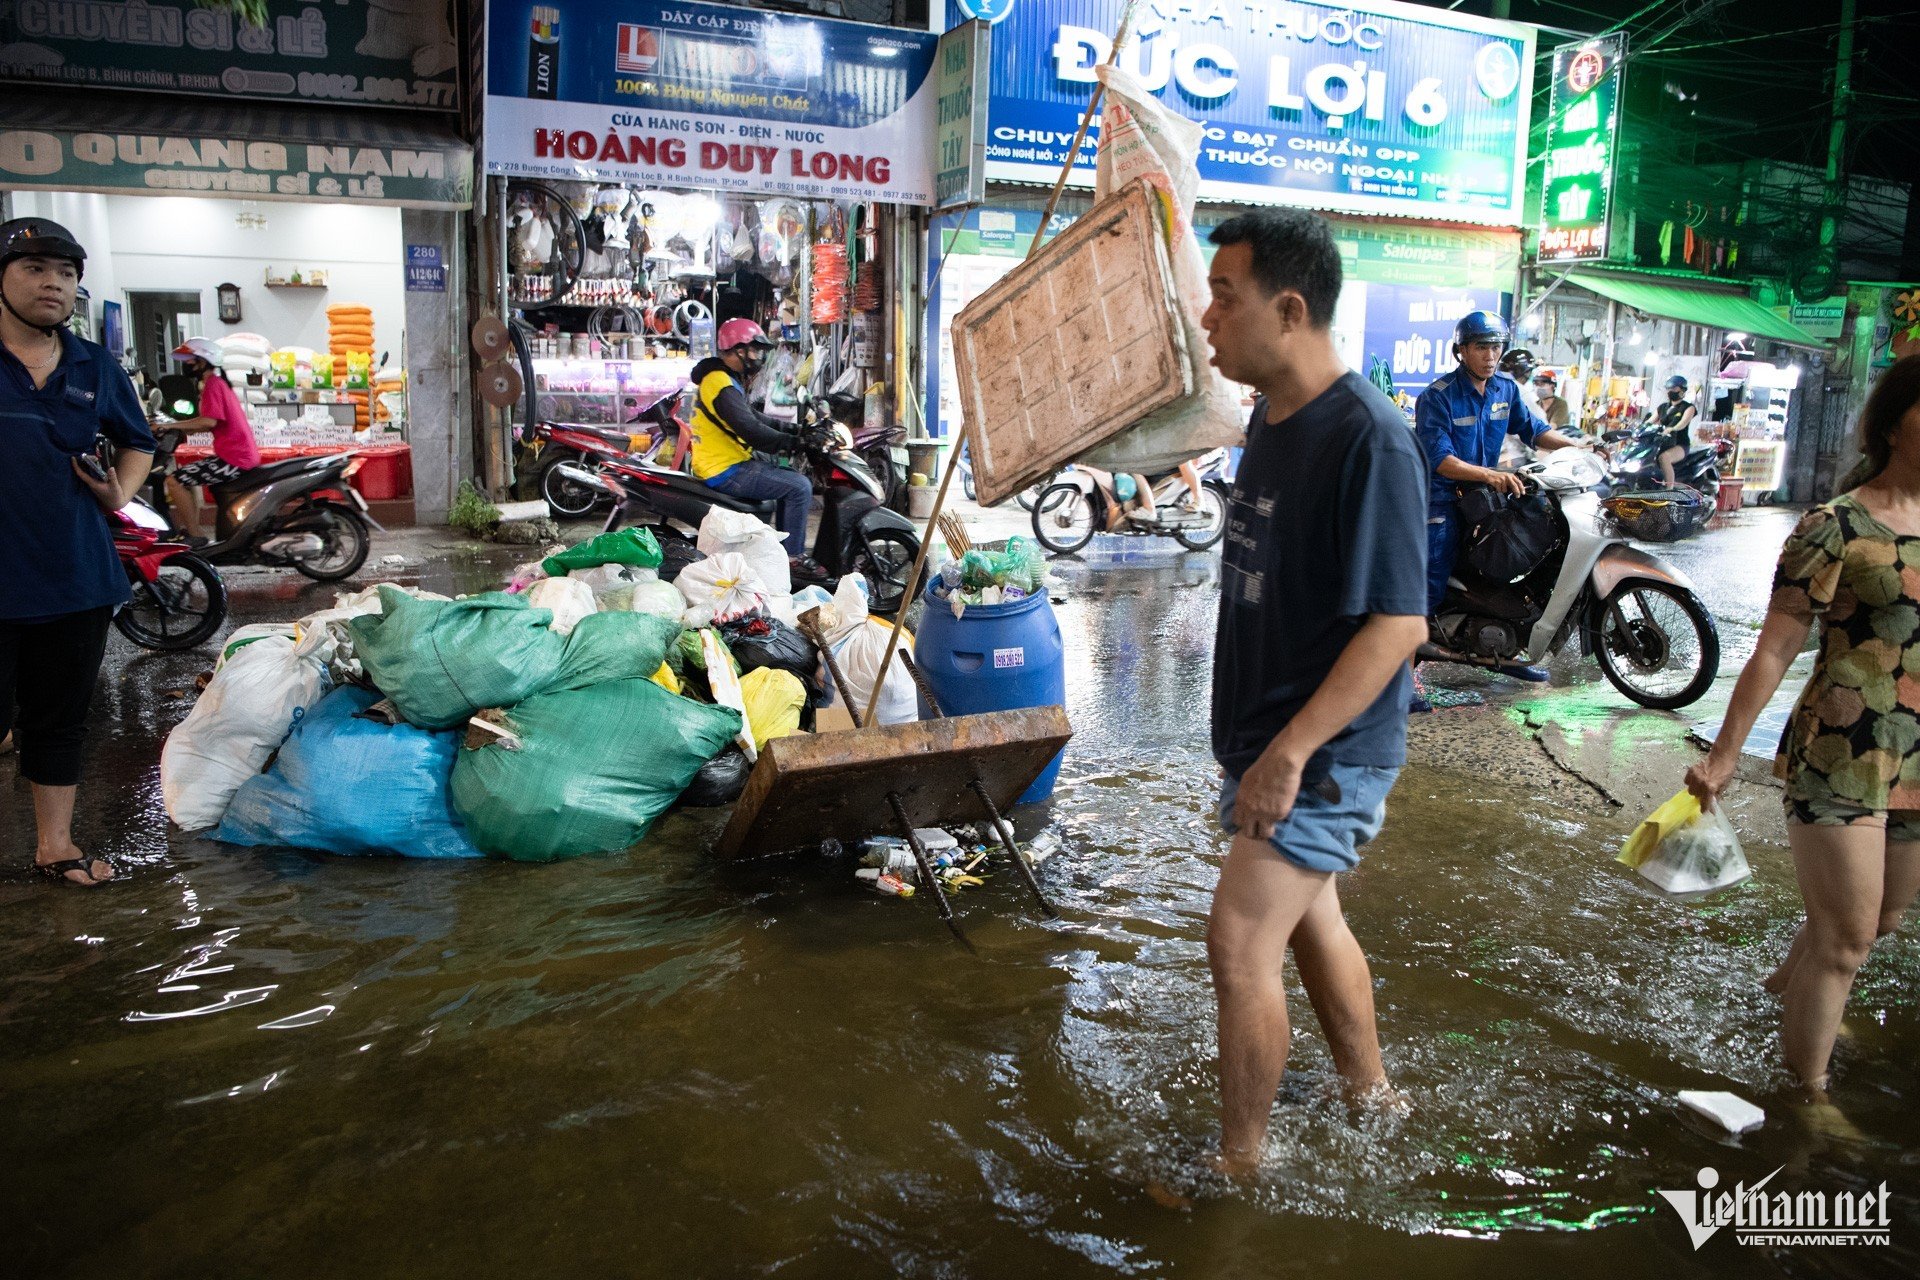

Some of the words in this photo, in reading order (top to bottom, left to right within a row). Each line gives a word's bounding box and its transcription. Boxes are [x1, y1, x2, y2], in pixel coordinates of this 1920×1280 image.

[18, 0, 183, 46] CHUYÊN
[237, 16, 274, 54] &
[277, 8, 328, 58] LẺ
[661, 9, 694, 25] DÂY
[697, 13, 729, 29] CÁP
[1244, 4, 1384, 50] THUỐC
[867, 36, 921, 50] daphaco.com
[179, 73, 219, 88] TP.HCM
[537, 53, 551, 93] LION
[1053, 22, 1239, 98] ĐỨC
[1268, 54, 1387, 128] LỢI
[1405, 77, 1448, 127] 6
[615, 78, 659, 97] 100%
[710, 88, 768, 110] Nguyên
[938, 76, 972, 126] THUỐC
[612, 112, 643, 127] CỬA
[649, 116, 690, 132] HÀNG
[695, 121, 725, 135] SƠN
[739, 124, 772, 140] ĐIỆN
[785, 128, 825, 144] NƯỚC
[534, 127, 687, 168] HOÀNG
[700, 141, 779, 175] DUY
[791, 148, 891, 185] LONG
[943, 131, 963, 169] TÂY
[986, 144, 1012, 157] CÔNG
[1012, 148, 1035, 161] NGHỆ
[1036, 148, 1054, 161] MỚI
[1232, 130, 1277, 148] ĐẠT
[1288, 137, 1368, 159] CHUẨN
[1550, 132, 1606, 178] THUỐC
[307, 145, 444, 179] NAM
[504, 163, 519, 171] 278
[1206, 147, 1287, 168] THUỐC
[1294, 157, 1335, 175] NỘI
[1342, 163, 1415, 184] NGOẠI
[145, 168, 270, 192] CHUYÊN
[317, 177, 342, 196] &
[777, 182, 794, 192] 0921
[796, 184, 809, 193] 088
[811, 185, 824, 194] 881
[831, 186, 848, 195] 0909
[850, 188, 862, 197] 523
[864, 189, 877, 198] 481
[883, 190, 899, 200] 0977
[914, 192, 927, 201] 592
[1558, 183, 1591, 221] TÂY
[983, 231, 1012, 240] Salonpas
[1545, 228, 1569, 249] ĐỨC
[1570, 229, 1589, 251] LỢI
[414, 247, 435, 258] 280
[1382, 242, 1448, 263] Salonpas
[1409, 299, 1434, 322] NHÀ
[1393, 333, 1432, 374] ĐỨC
